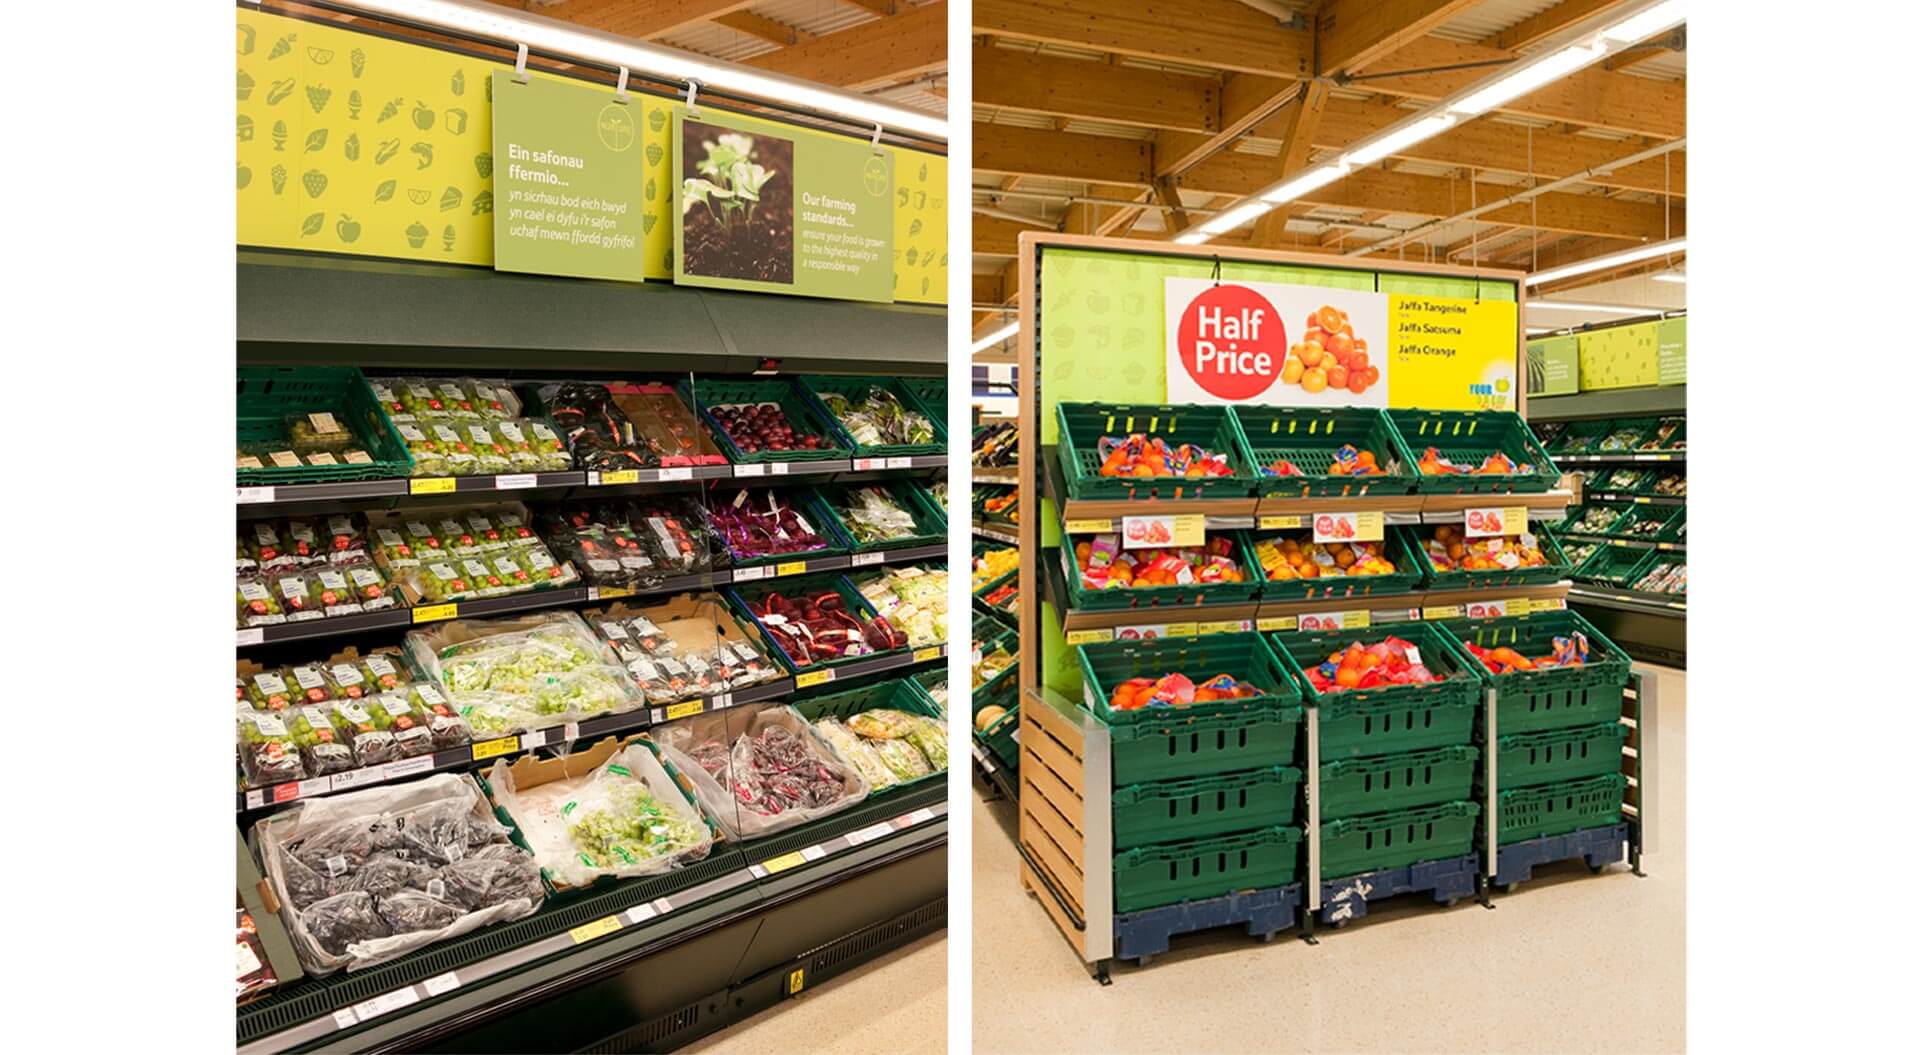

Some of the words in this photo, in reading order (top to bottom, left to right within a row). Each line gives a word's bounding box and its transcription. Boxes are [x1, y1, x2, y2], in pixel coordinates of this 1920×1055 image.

[508, 143, 530, 160] Ein
[532, 150, 584, 169] safonau
[508, 164, 569, 187] ffermio...
[509, 190, 522, 202] yn
[524, 191, 559, 205] sicrhau
[560, 195, 579, 208] bod
[581, 198, 600, 211] eich
[601, 200, 627, 215] bwyd
[802, 191, 820, 206] Our
[822, 195, 856, 215] farming
[509, 208, 522, 220] yn
[524, 209, 545, 221] cael
[546, 212, 555, 222] ei
[556, 213, 578, 226] dyfu
[591, 217, 616, 230] safon
[510, 224, 539, 240] uchaf
[540, 229, 570, 241] mewn
[571, 230, 601, 245] ffordd
[1398, 301, 1422, 311] Jaffa
[1423, 302, 1467, 314] Tangerine
[1199, 305, 1264, 341] Half
[1398, 323, 1422, 333] Jaffa
[1423, 324, 1461, 335] Satsuma
[1196, 341, 1272, 376] Price
[1398, 344, 1421, 354] Jaffa
[1423, 345, 1456, 357] Orange
